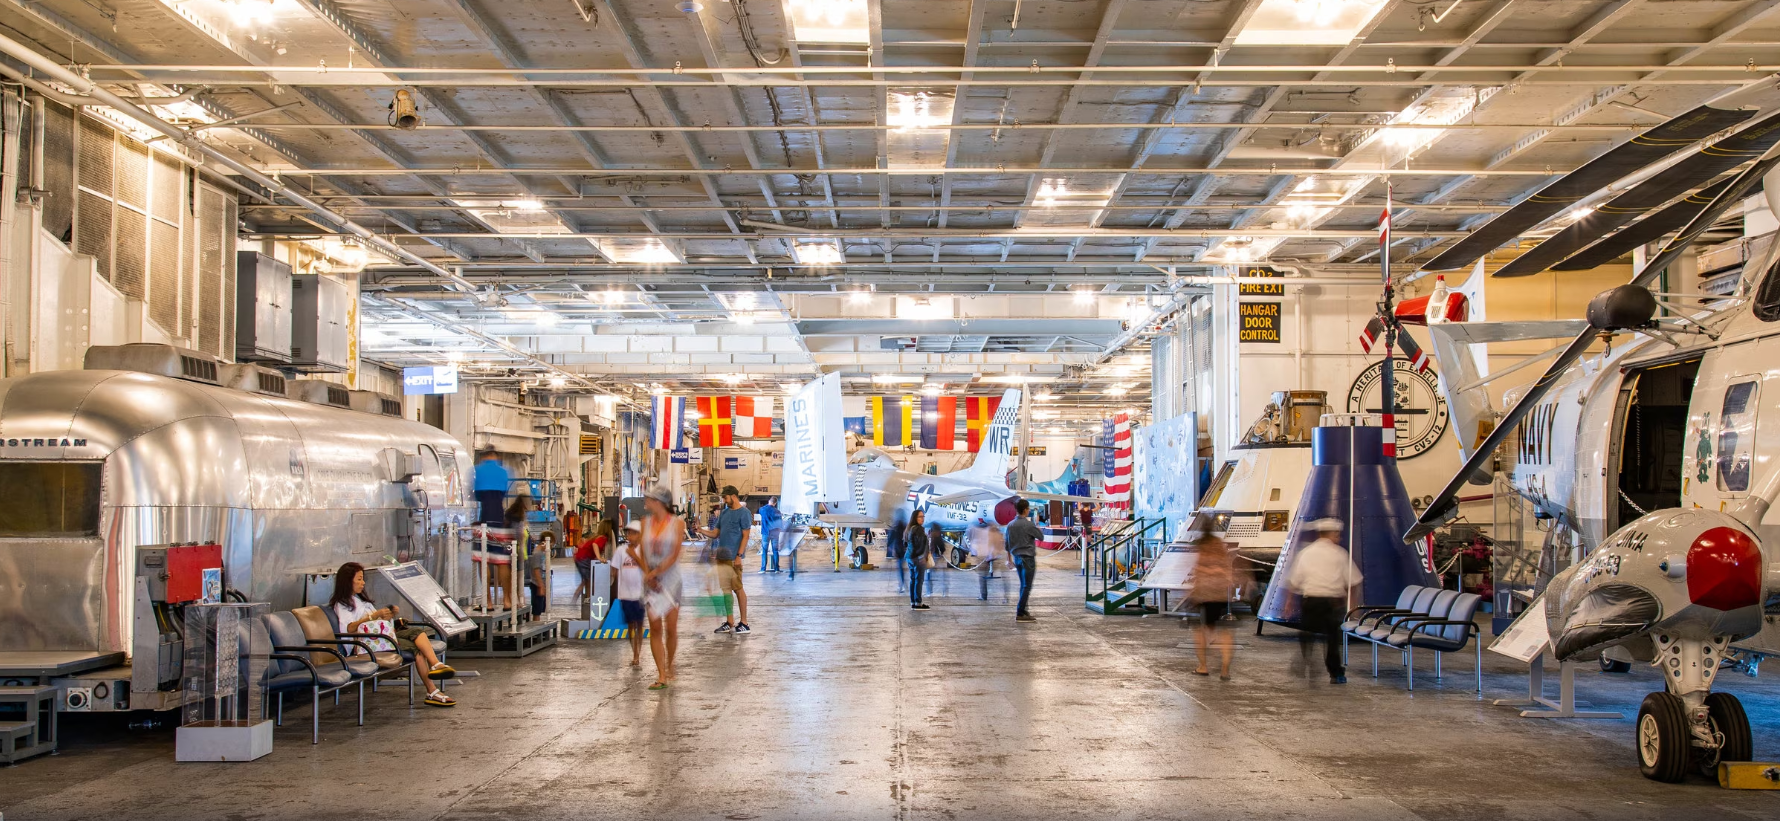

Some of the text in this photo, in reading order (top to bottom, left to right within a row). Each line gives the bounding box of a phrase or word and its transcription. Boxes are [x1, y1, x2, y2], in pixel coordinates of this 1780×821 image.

[1240, 283, 1262, 293] FIRE
[1240, 304, 1278, 316] HANGAR
[1244, 317, 1273, 328] DOOR
[1240, 329, 1279, 341] CONTROL
[412, 376, 434, 386] EXIT
[1351, 395, 1359, 403] A
[1396, 361, 1406, 369] OF
[989, 426, 1010, 455] WR
[1414, 425, 1443, 452] CVS-12
[1518, 402, 1560, 465] NAVY
[792, 398, 819, 497] MARINES
